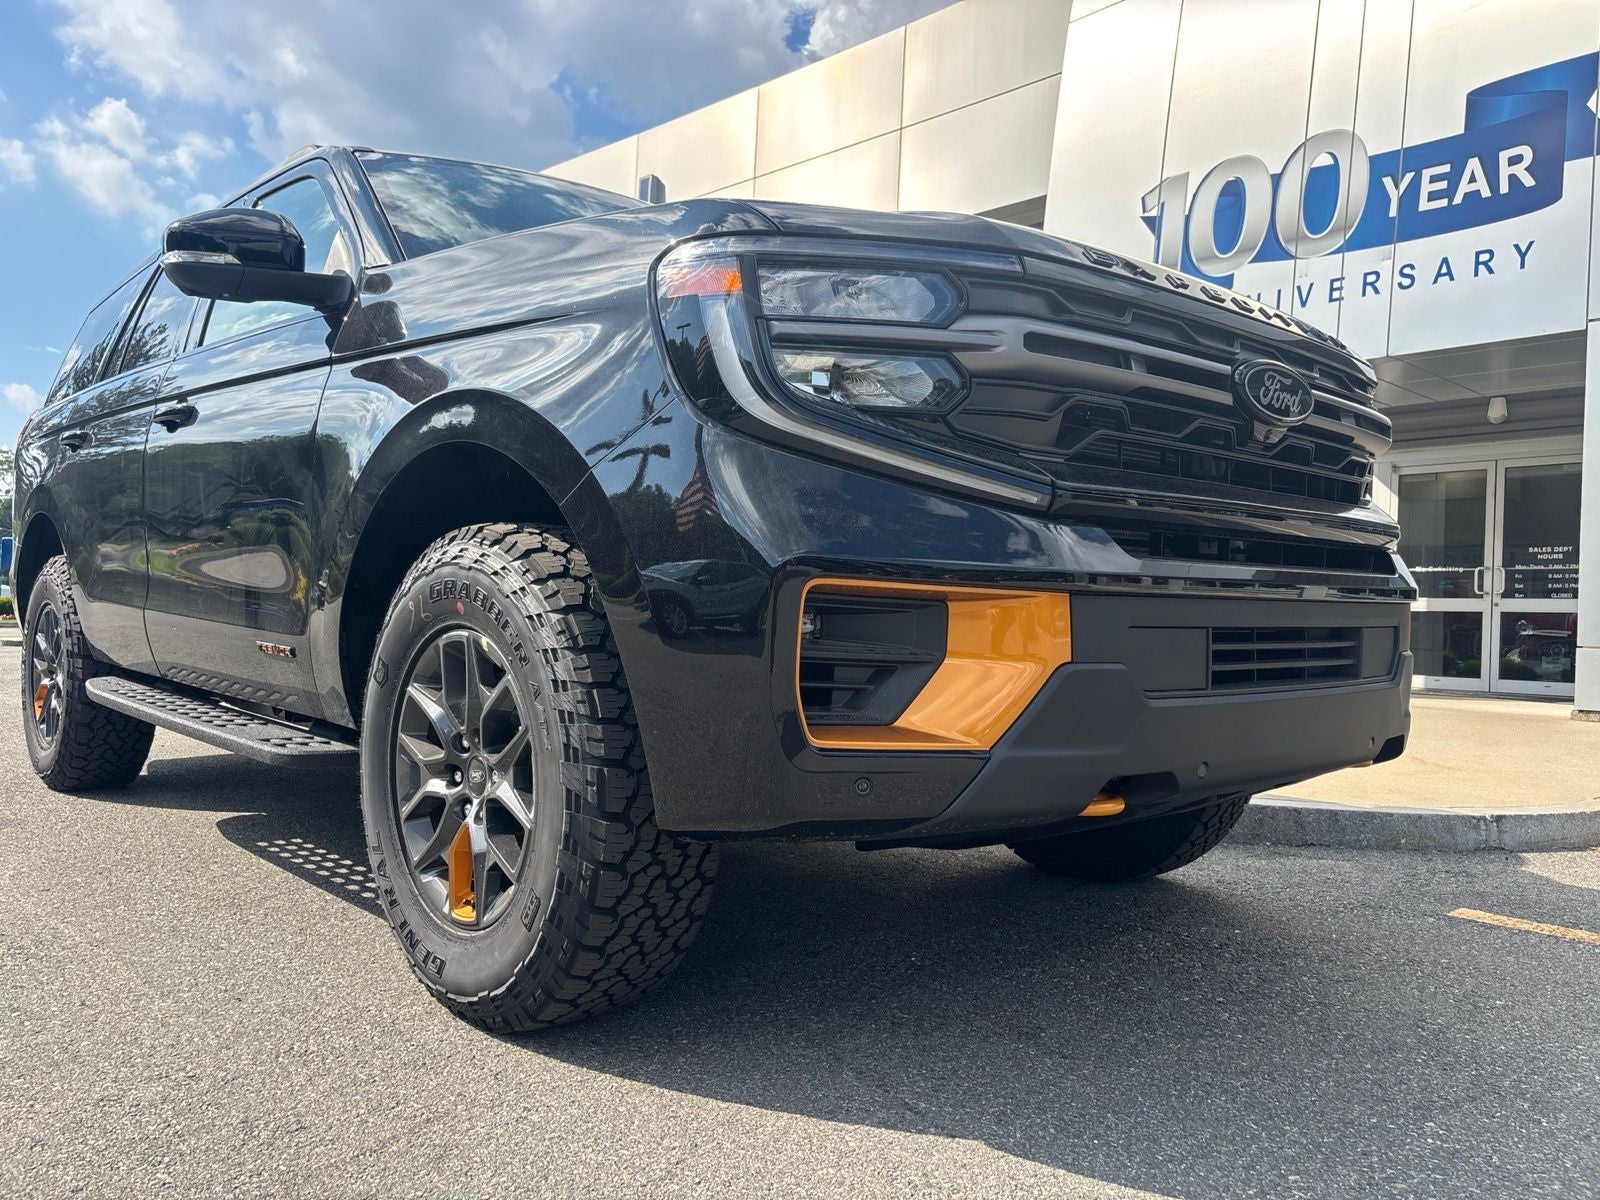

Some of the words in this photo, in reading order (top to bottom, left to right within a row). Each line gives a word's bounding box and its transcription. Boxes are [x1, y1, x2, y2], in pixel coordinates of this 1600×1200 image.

[1141, 129, 1370, 277] 100
[1381, 144, 1536, 218] YEAR
[1247, 240, 1536, 311] IVERSARY
[1259, 371, 1302, 414] Ford
[429, 578, 531, 672] GRABBER
[372, 831, 446, 979] GENERAL
